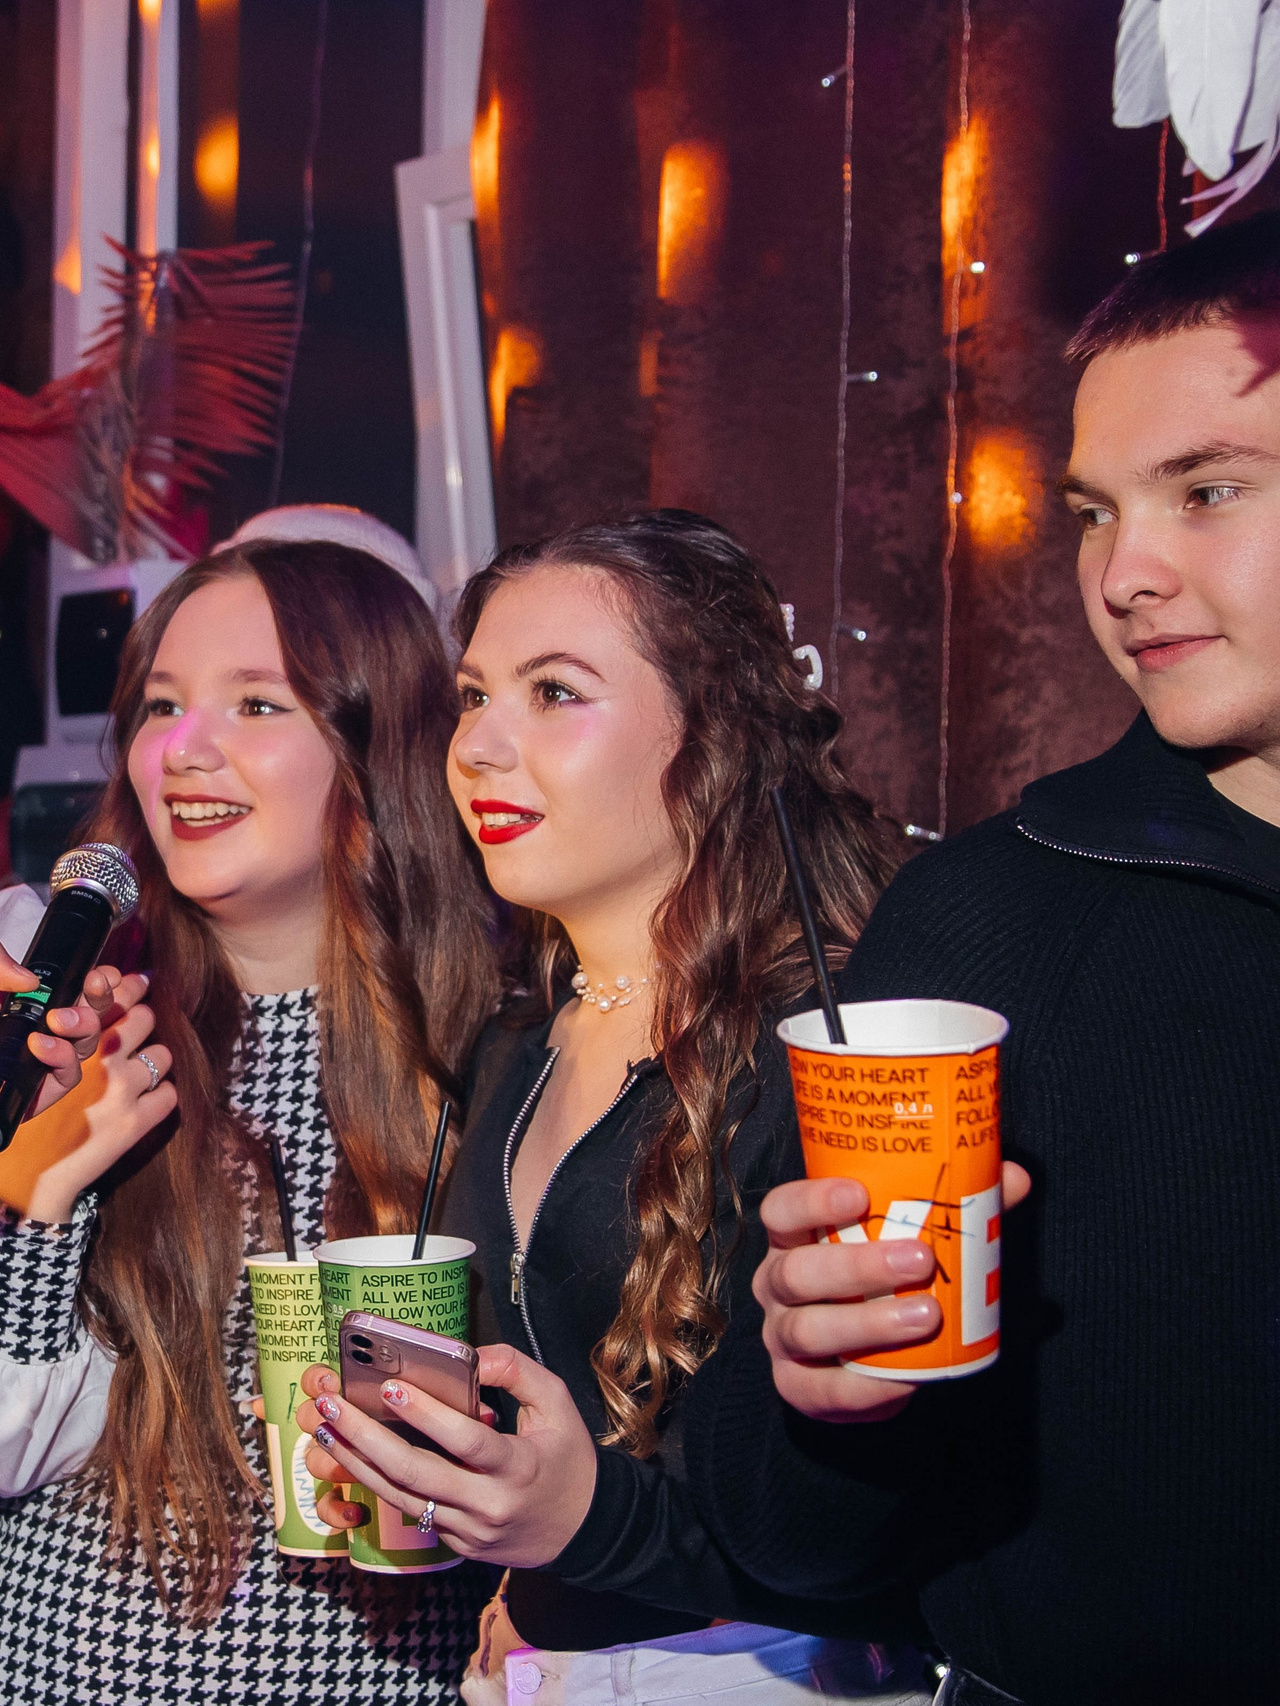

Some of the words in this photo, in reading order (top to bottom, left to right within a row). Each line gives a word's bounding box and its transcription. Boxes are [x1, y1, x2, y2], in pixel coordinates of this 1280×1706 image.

[811, 1063, 856, 1082] YOUR
[860, 1067, 930, 1084] HEART
[811, 1085, 824, 1101] IS
[826, 1087, 837, 1103] A
[839, 1090, 930, 1107] MOMENT
[956, 1086, 986, 1104] ALL
[830, 1109, 853, 1128] TO
[818, 1130, 858, 1150] NEED
[862, 1134, 879, 1152] IS
[883, 1137, 933, 1154] LOVE
[956, 1134, 969, 1149] A
[256, 1272, 306, 1286] MOMENT
[321, 1270, 351, 1285] HEART
[361, 1273, 415, 1288] ASPIRE
[418, 1271, 438, 1286] TO
[255, 1287, 264, 1300] TO
[266, 1288, 315, 1301] INSPIRE
[362, 1291, 389, 1304] ALL
[393, 1290, 418, 1304] WE
[422, 1285, 455, 1302] NEED
[457, 1281, 465, 1295] IS
[256, 1302, 277, 1316] NEED
[279, 1304, 292, 1316] IS
[427, 1300, 459, 1317] YOUR
[275, 1320, 316, 1332] HEART
[261, 1334, 309, 1347] MOMENT
[261, 1348, 270, 1361] TO
[272, 1350, 317, 1362] INSPIRE
